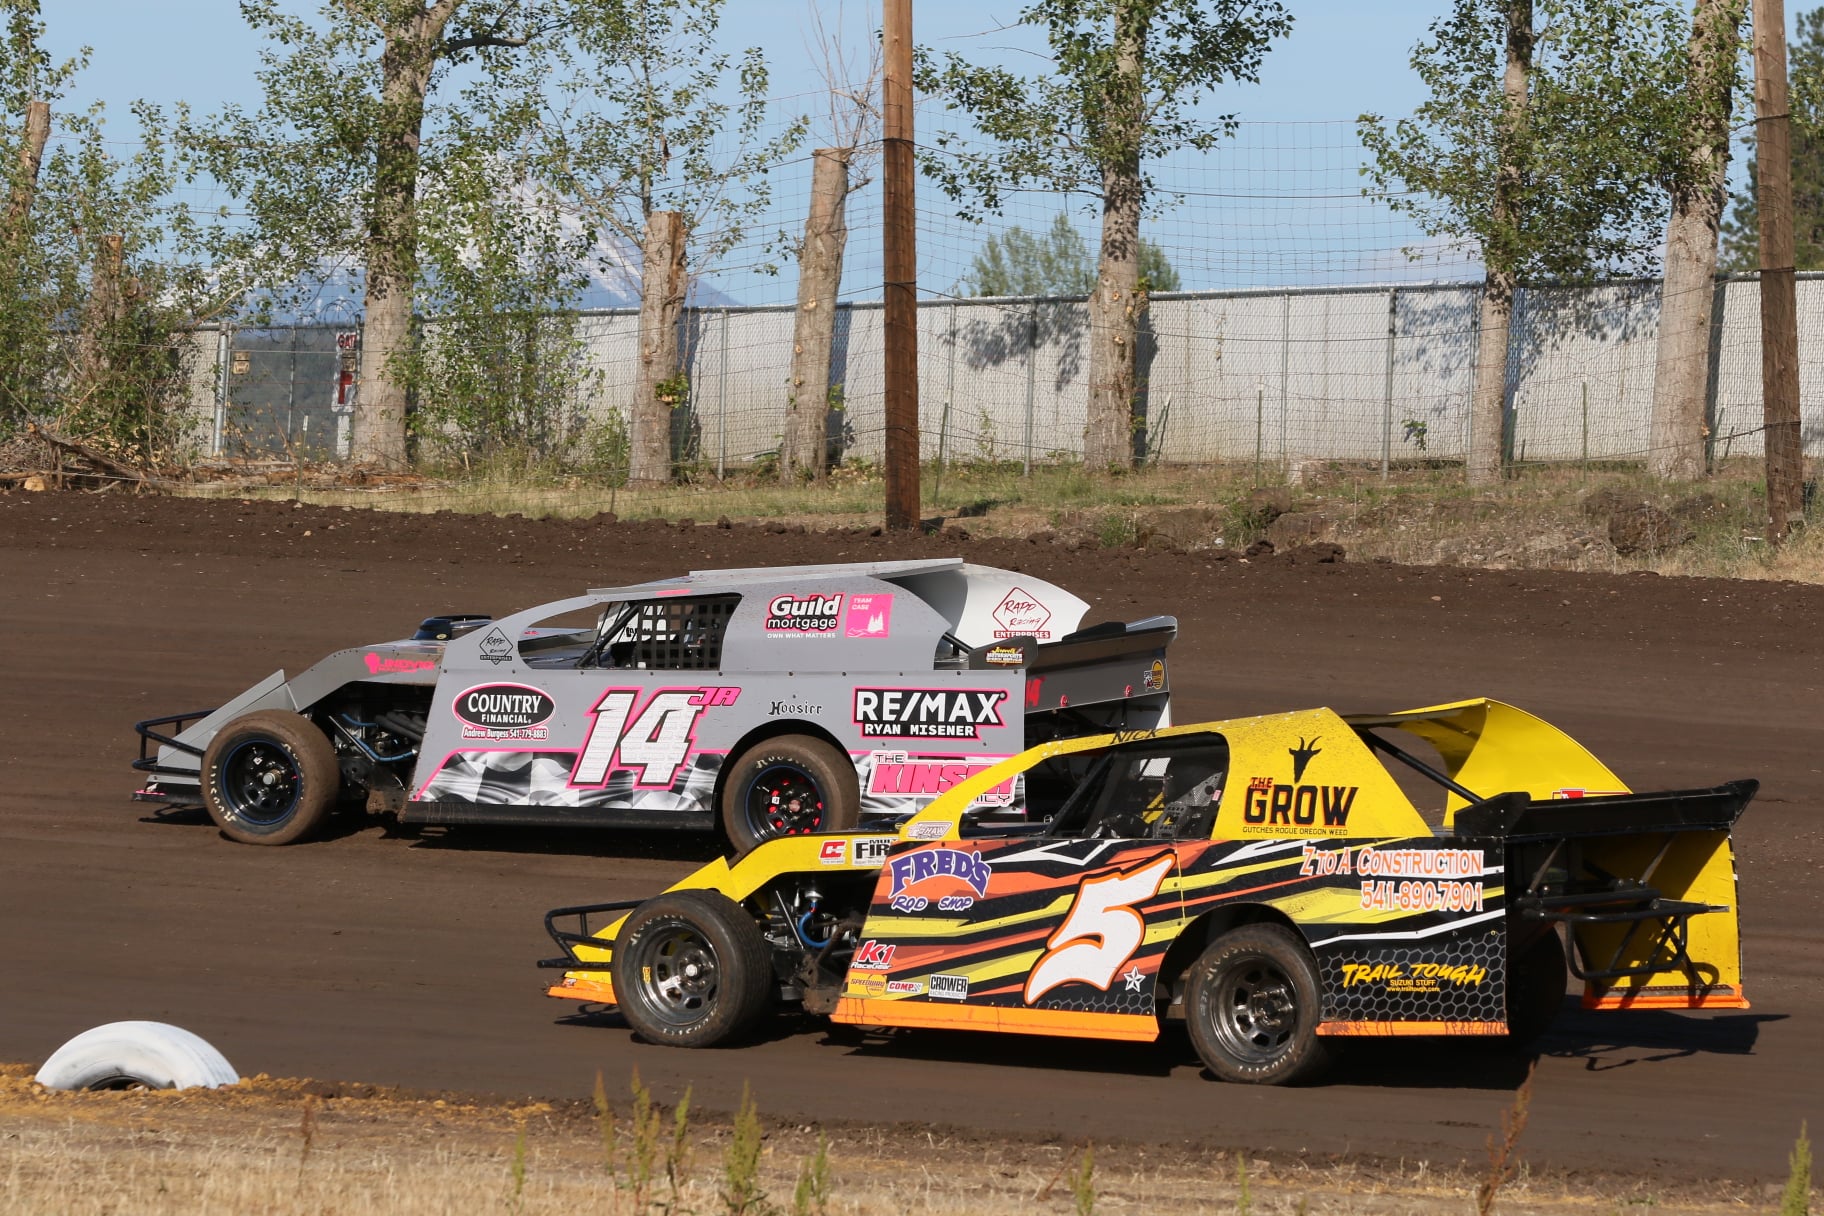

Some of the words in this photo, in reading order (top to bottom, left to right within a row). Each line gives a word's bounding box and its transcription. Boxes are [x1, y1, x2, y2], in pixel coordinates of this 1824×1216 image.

[770, 594, 842, 616] Guild
[767, 618, 837, 630] mortgage
[467, 692, 542, 713] COUNTRY
[768, 701, 823, 715] Hoosier
[856, 690, 1000, 723] RE/MAX
[464, 728, 486, 737] Andrew
[486, 728, 509, 739] Burgess
[570, 689, 706, 786] 14
[865, 724, 901, 735] RYAN
[910, 724, 974, 736] MISENER
[875, 754, 905, 764] THE
[1250, 777, 1274, 789] THE
[1244, 784, 1360, 828] GROW
[855, 842, 890, 859] FIR
[1301, 847, 1316, 874] Z
[1337, 847, 1350, 874] A
[889, 849, 991, 897] FRED'S
[892, 896, 928, 912] ROD
[939, 896, 973, 911] SHOP
[1361, 881, 1483, 910] 541-890-7901
[1025, 849, 1177, 1005] 5
[857, 940, 896, 964] K1
[889, 982, 914, 990] COMP
[930, 976, 967, 992] CROWER
[1342, 963, 1403, 988] TRAIL
[1410, 963, 1486, 986] TOUGH
